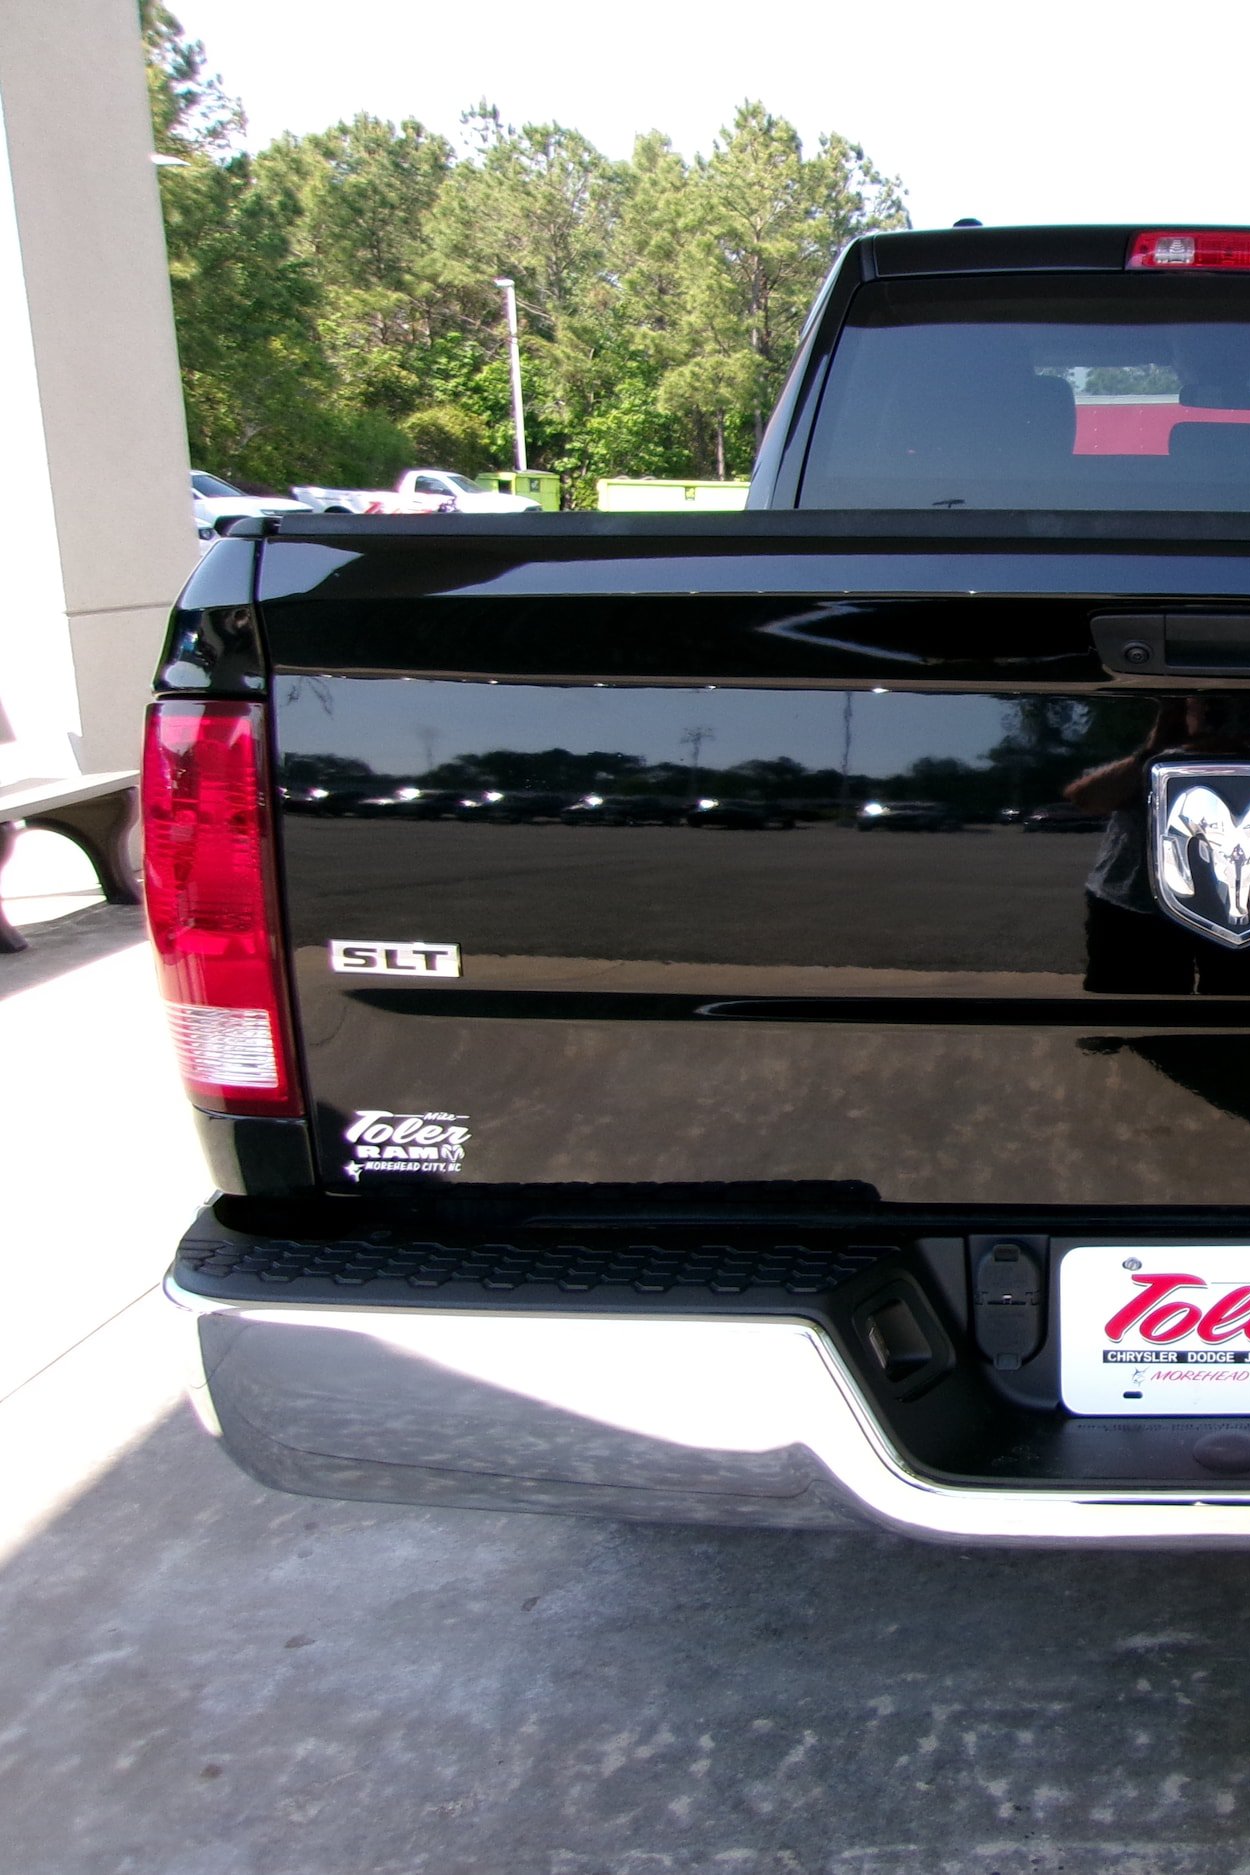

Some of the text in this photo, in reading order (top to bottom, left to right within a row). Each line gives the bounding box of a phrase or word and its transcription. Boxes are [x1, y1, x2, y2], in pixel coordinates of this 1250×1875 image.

[342, 946, 449, 971] SLT
[423, 1111, 457, 1122] Mike
[345, 1109, 473, 1145] Toler
[356, 1145, 439, 1160] RAM
[364, 1161, 421, 1172] MOREHEAD
[447, 1162, 462, 1172] NC
[1107, 1350, 1178, 1364] CHRYSLER
[1186, 1350, 1235, 1364] DODGE
[1150, 1369, 1249, 1382] MOREHEAD
